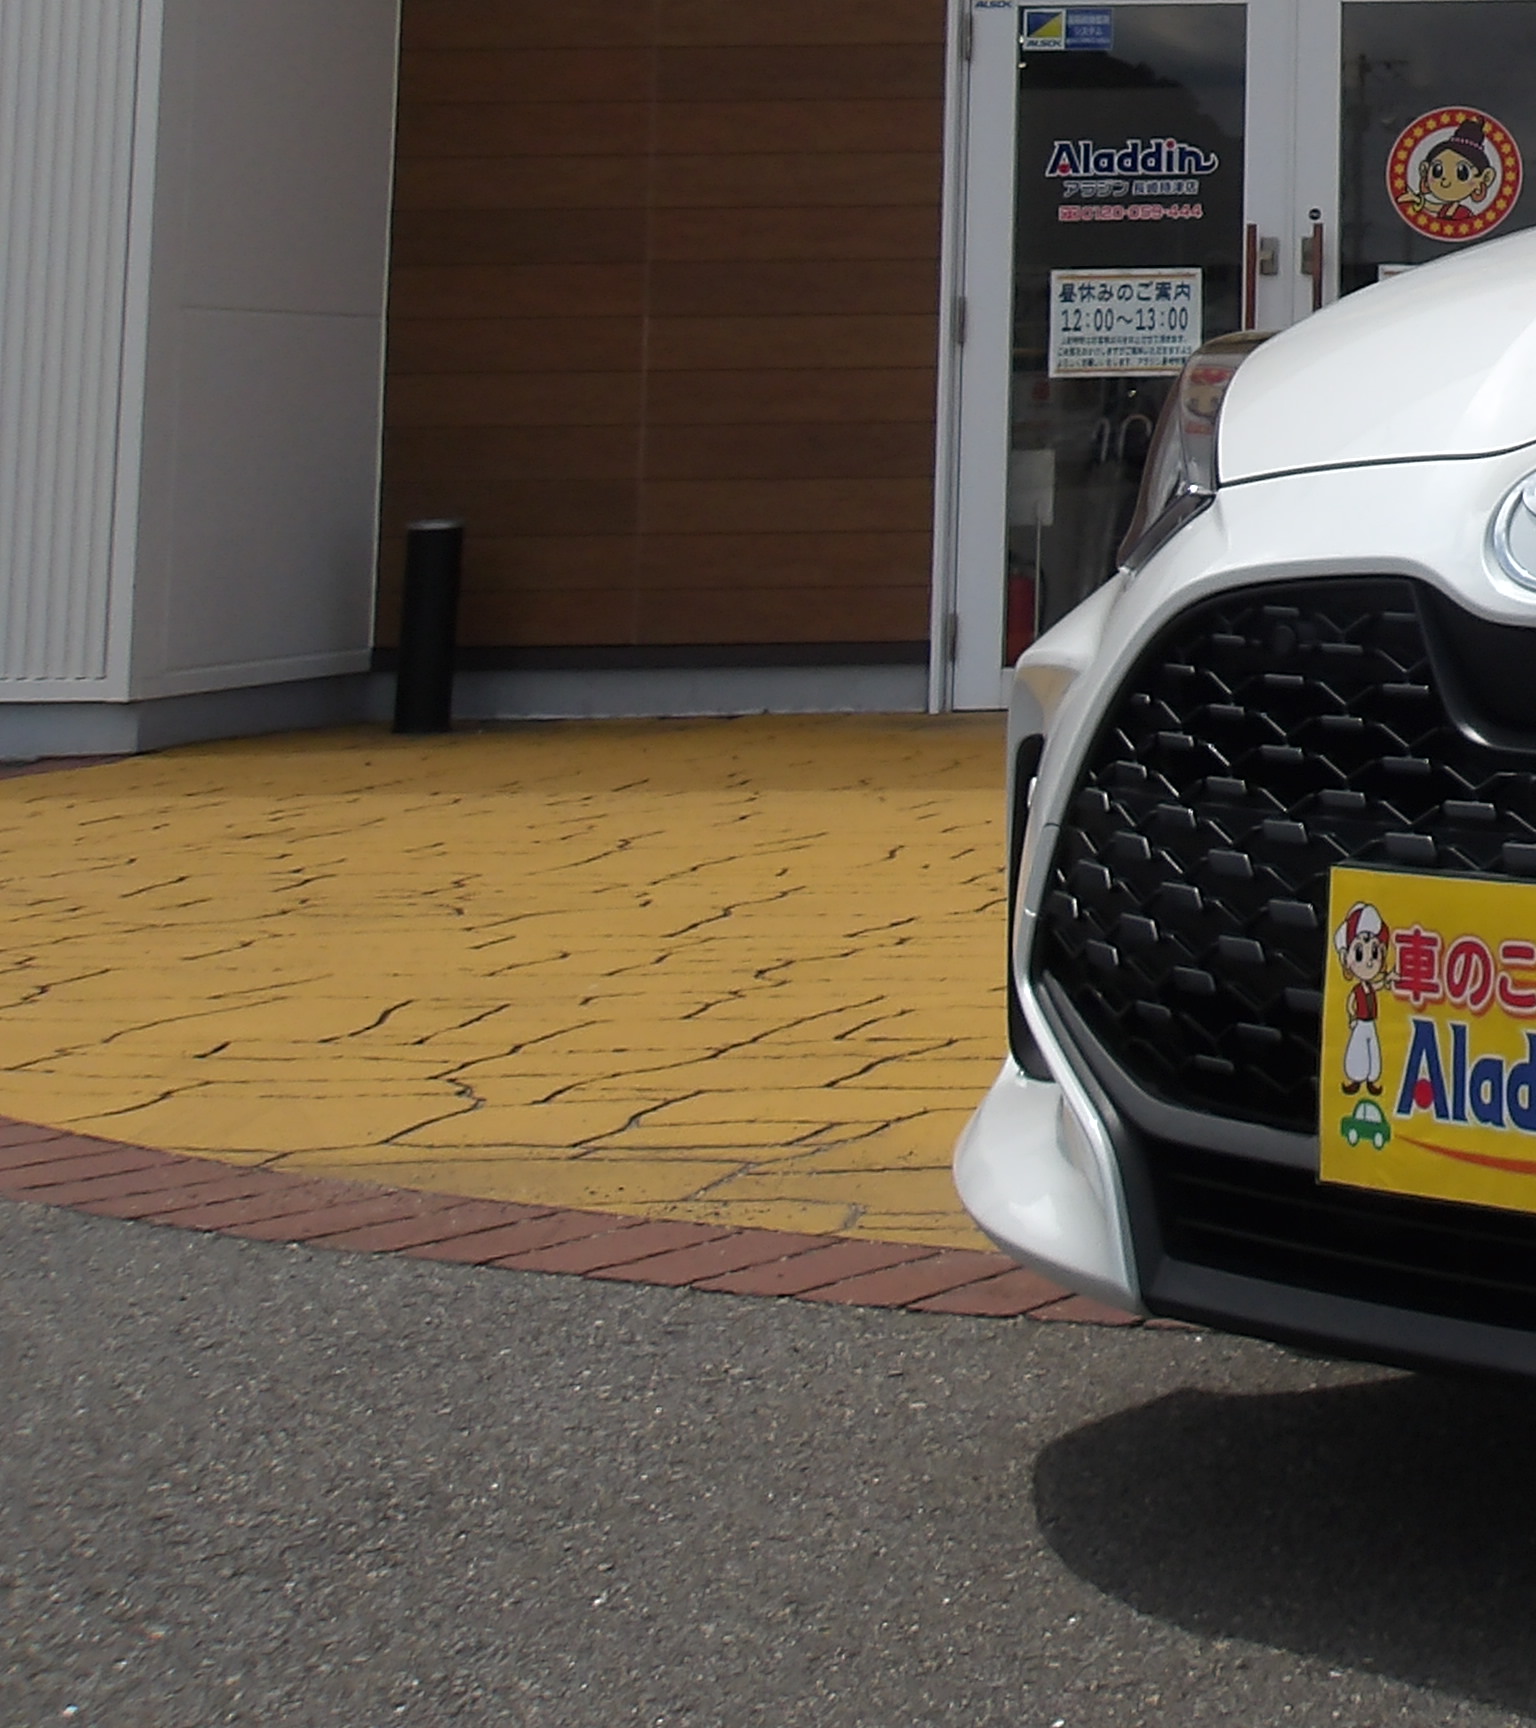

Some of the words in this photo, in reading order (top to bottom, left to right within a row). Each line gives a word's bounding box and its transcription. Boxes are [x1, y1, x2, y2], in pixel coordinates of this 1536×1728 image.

[1046, 138, 1219, 177] Aladdin
[1063, 180, 1129, 198] アラジン
[1059, 282, 1191, 303] 昼休みのご案内
